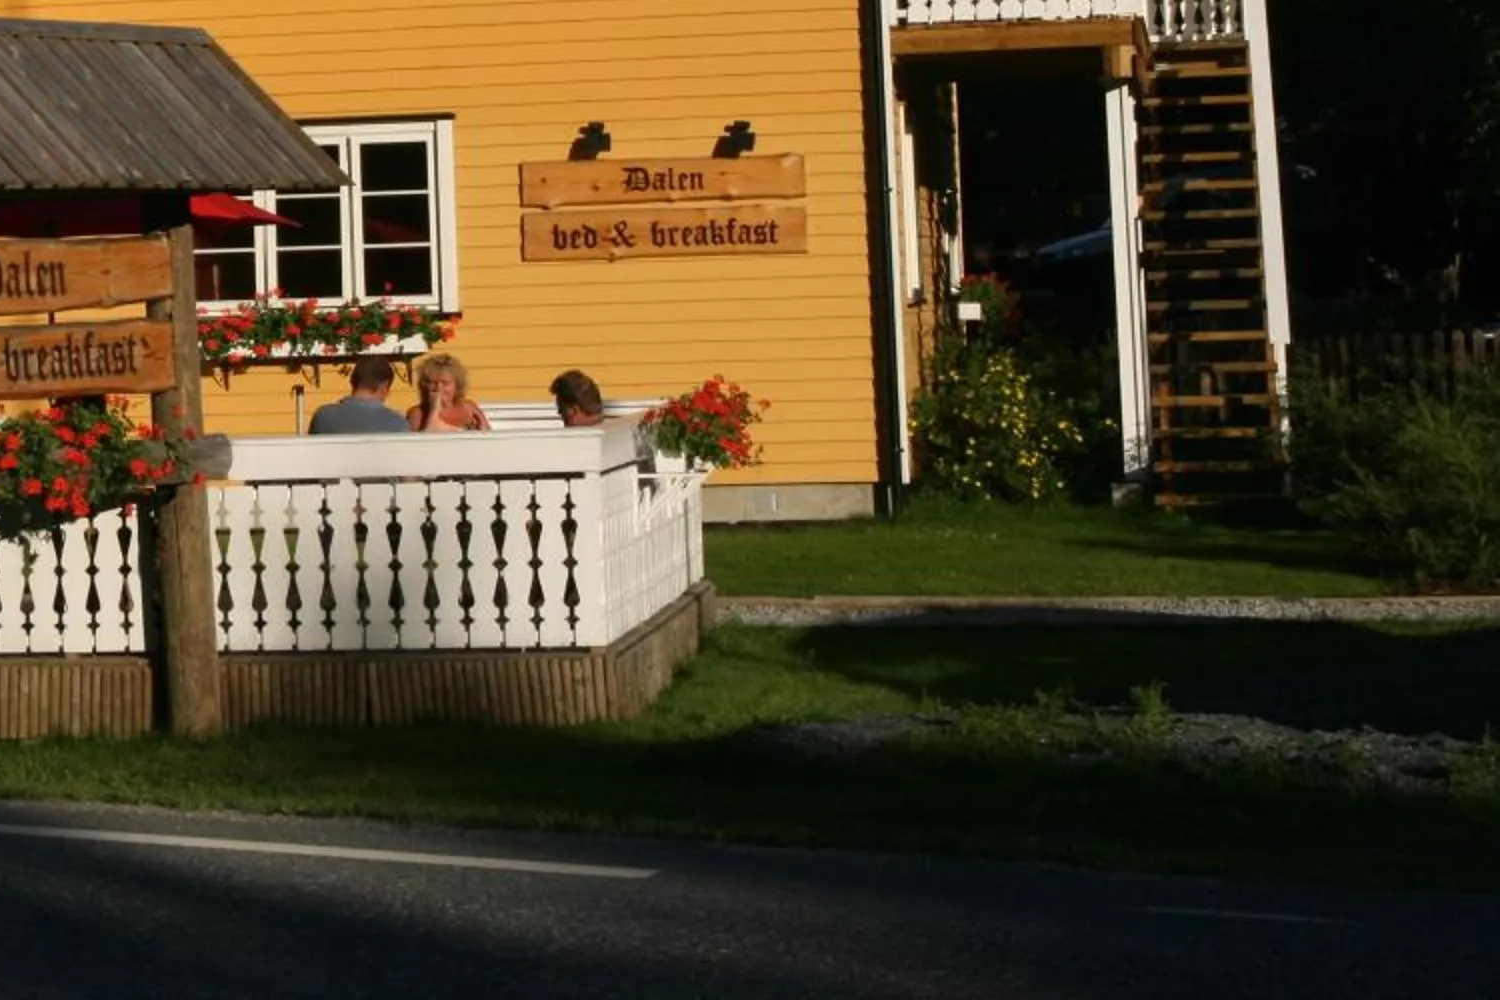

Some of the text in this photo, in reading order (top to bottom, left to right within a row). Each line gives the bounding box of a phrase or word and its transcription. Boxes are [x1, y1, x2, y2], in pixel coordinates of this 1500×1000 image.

[622, 167, 704, 192] Dalen
[552, 219, 779, 250] bed & breakfast
[3, 331, 138, 382] breakfast
